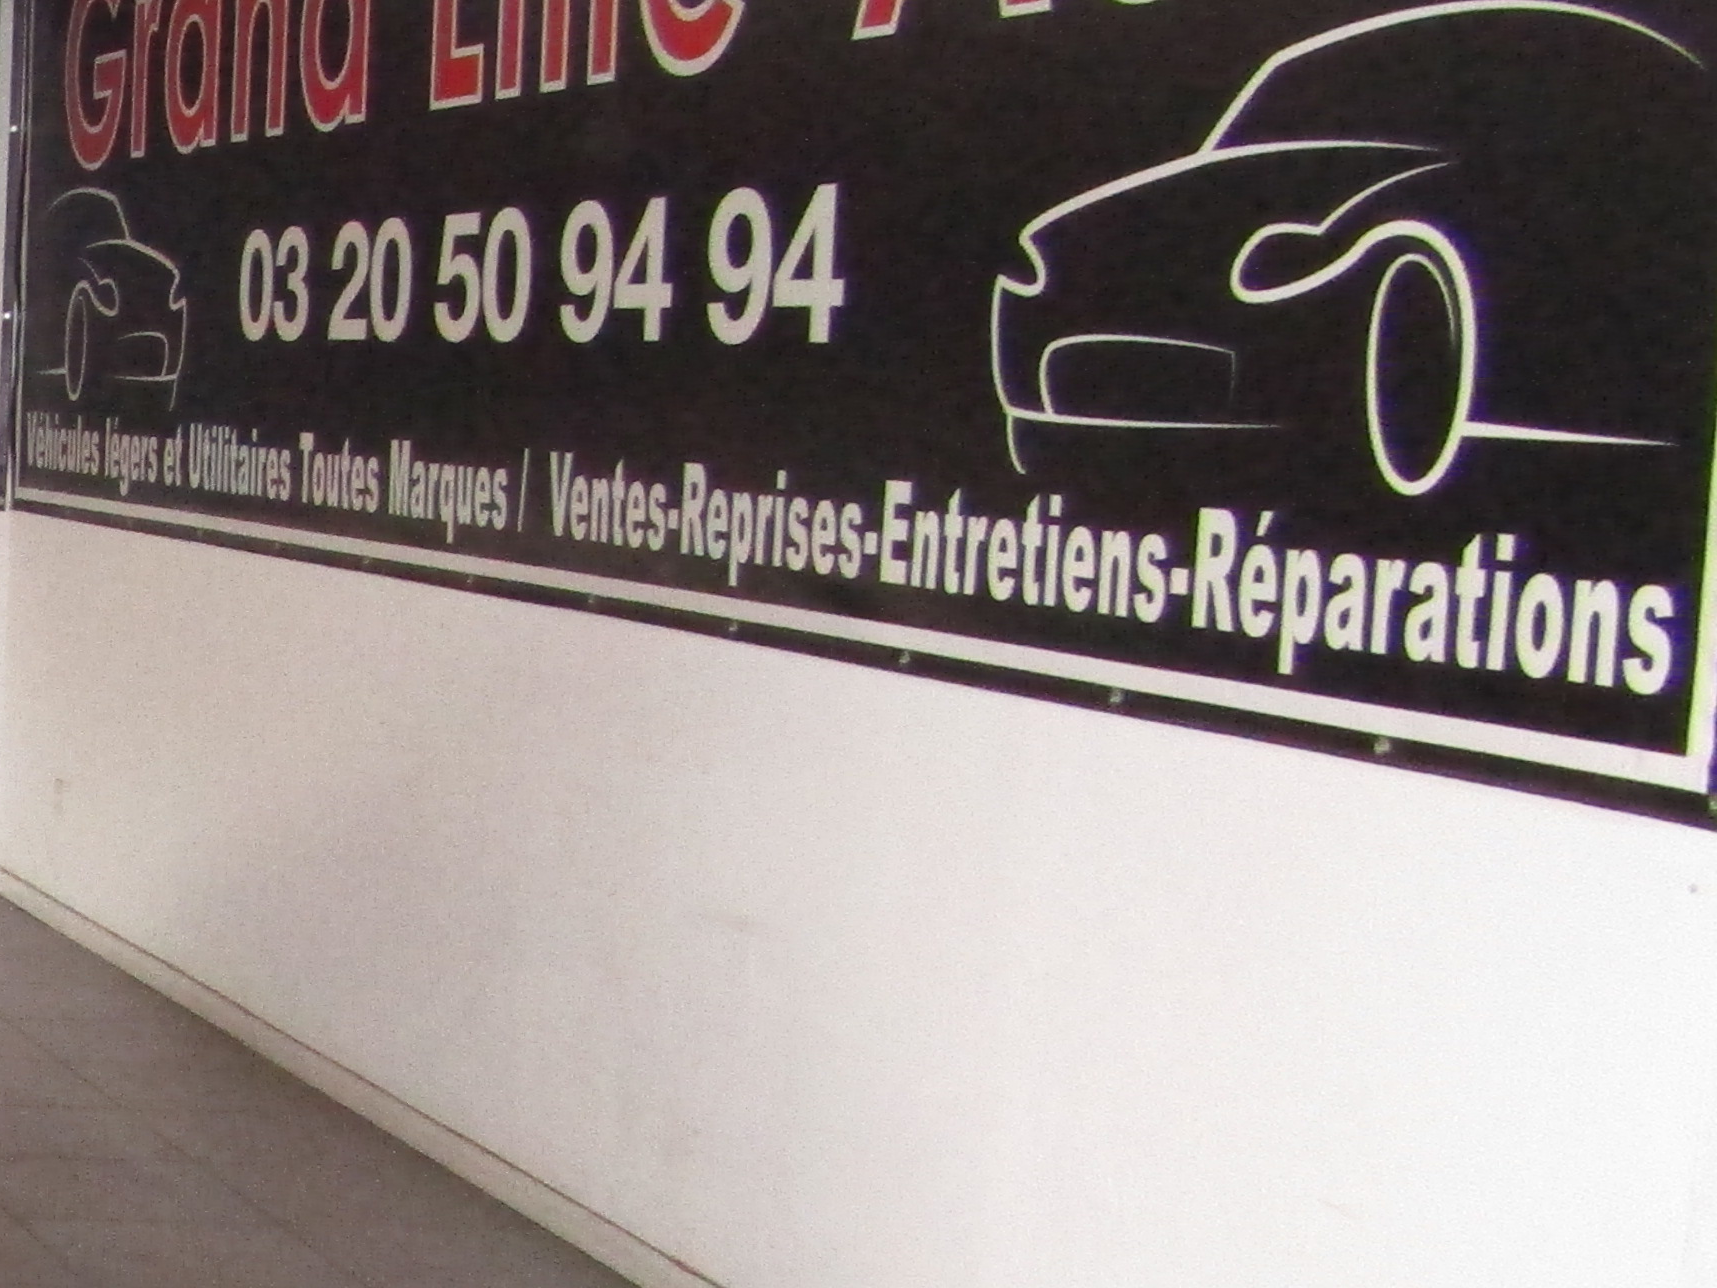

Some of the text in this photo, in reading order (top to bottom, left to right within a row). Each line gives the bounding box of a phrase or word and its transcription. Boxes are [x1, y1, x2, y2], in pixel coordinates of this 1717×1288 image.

[240, 183, 845, 345] 03 20 50 94 94
[26, 412, 100, 475] Véhicules
[105, 417, 159, 496] légers
[165, 423, 183, 487] et
[189, 423, 291, 501] Utilitaires
[298, 432, 380, 512] Toutes
[388, 439, 508, 544] Marques
